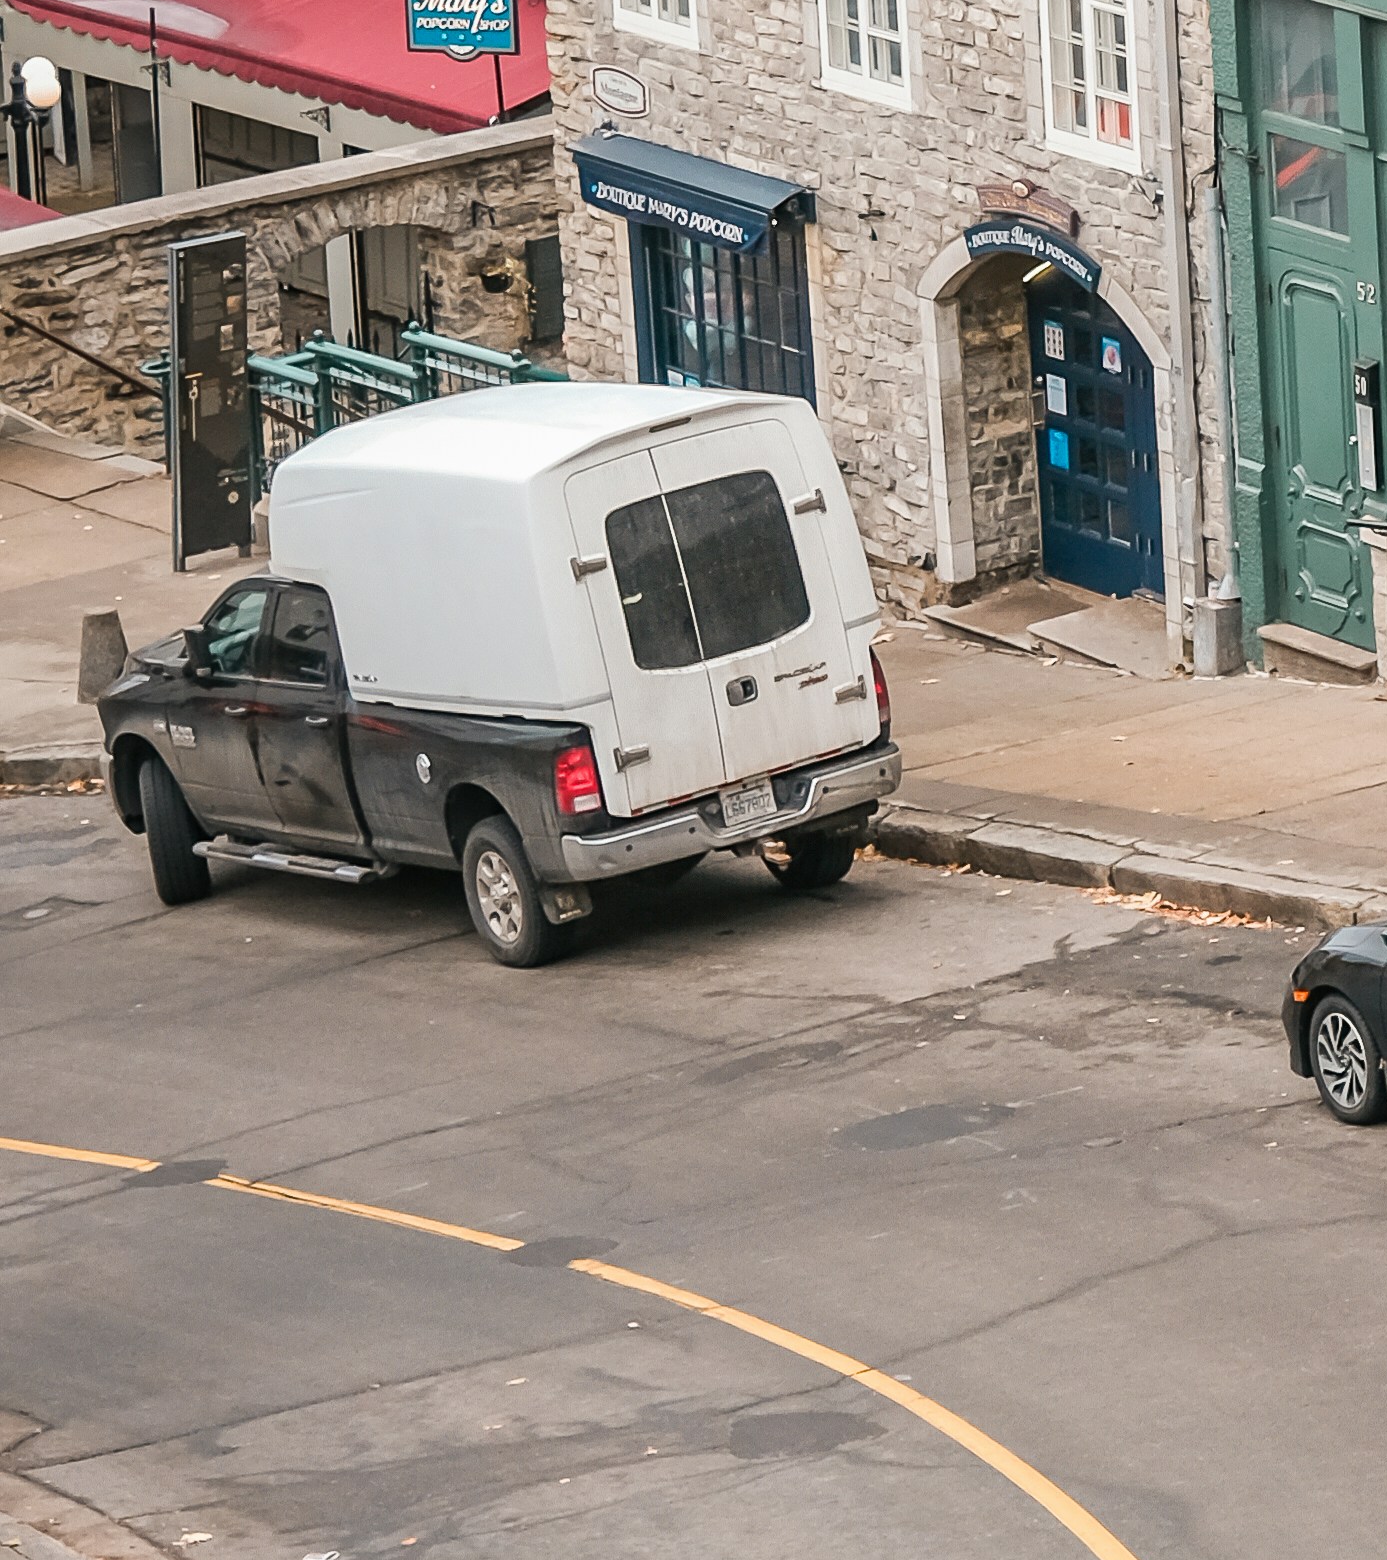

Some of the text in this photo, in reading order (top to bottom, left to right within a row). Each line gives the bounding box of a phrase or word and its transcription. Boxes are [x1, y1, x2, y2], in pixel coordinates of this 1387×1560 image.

[416, 17, 471, 30] POPCORN
[596, 181, 744, 244] BOUTIQUE MARY'S POPCORN
[1356, 280, 1377, 304] 52
[1354, 374, 1368, 397] 50
